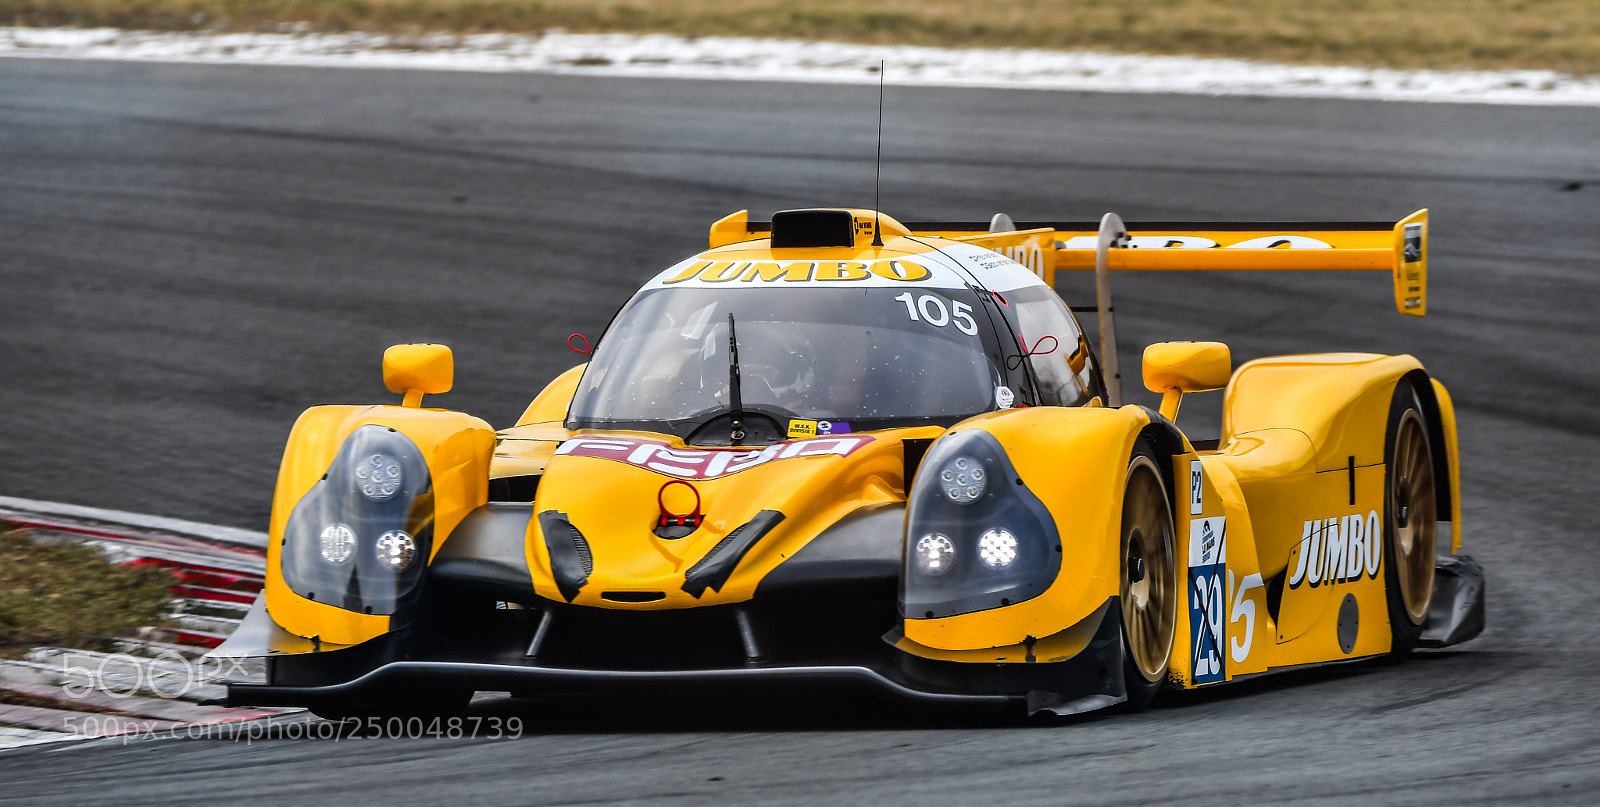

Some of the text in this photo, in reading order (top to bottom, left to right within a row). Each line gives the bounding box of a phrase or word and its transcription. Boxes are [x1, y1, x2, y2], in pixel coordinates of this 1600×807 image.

[662, 258, 932, 285] JUMBO
[894, 291, 978, 337] 105
[554, 437, 861, 477] FEBO
[1191, 471, 1202, 504] P2
[1289, 510, 1382, 590] JUMBO
[1193, 573, 1223, 676] 29
